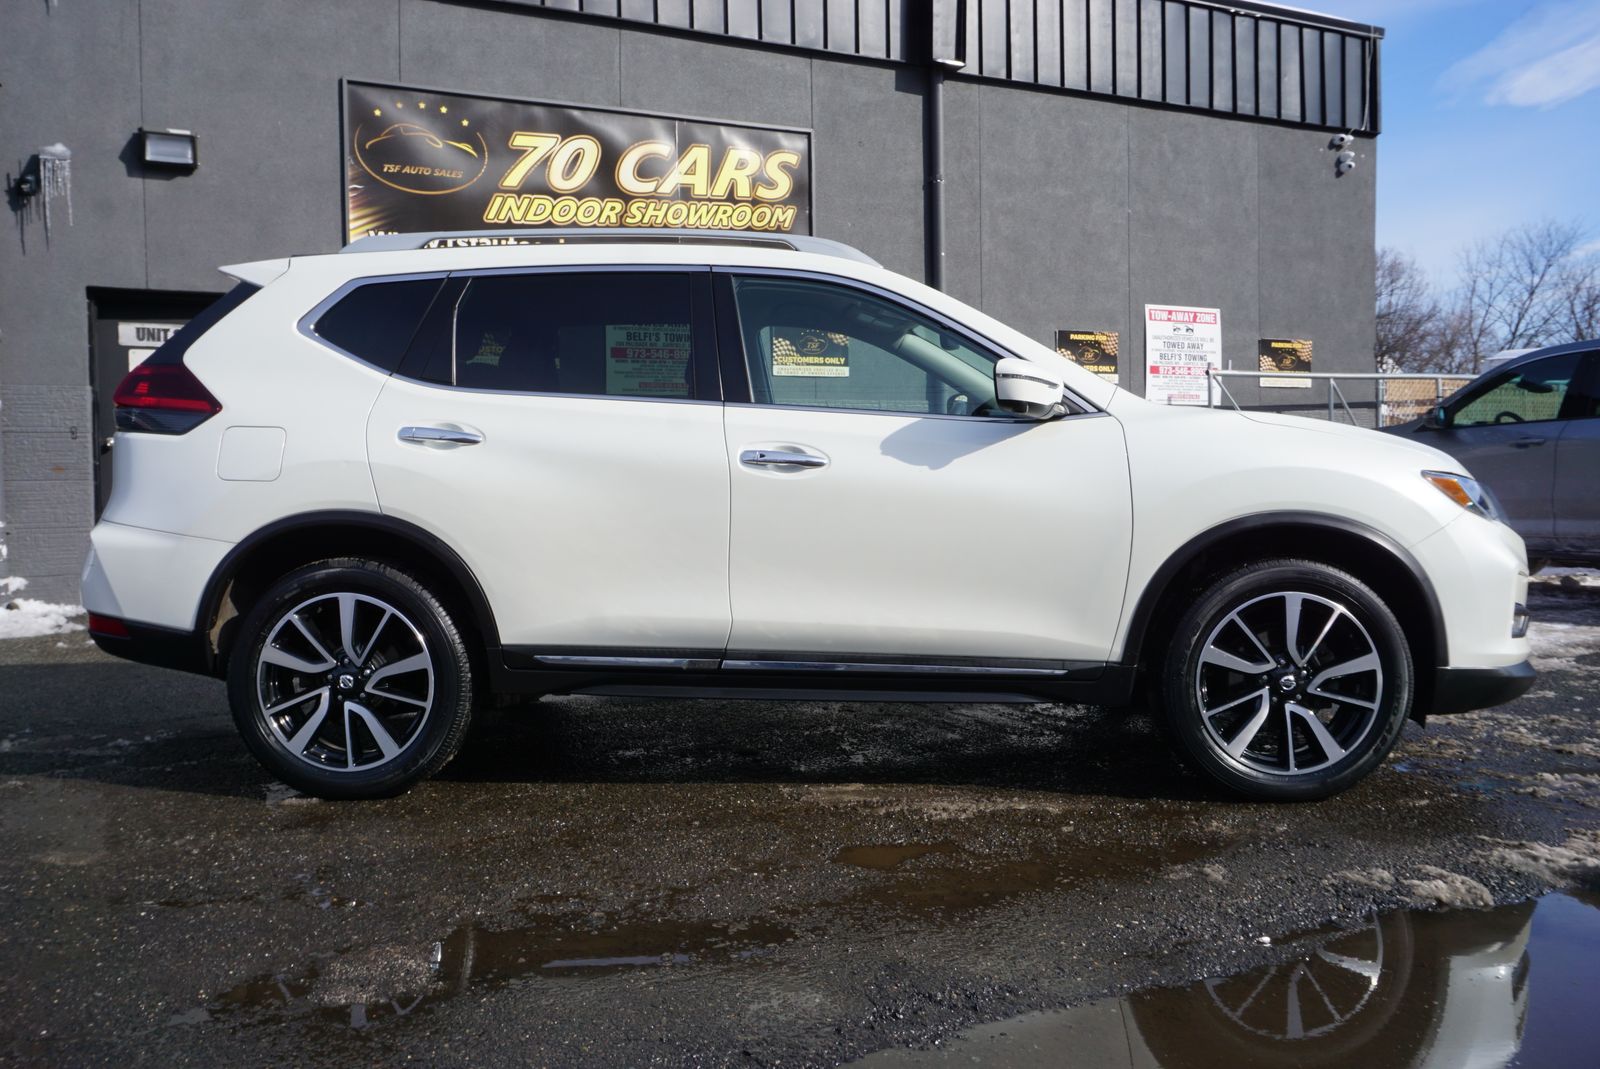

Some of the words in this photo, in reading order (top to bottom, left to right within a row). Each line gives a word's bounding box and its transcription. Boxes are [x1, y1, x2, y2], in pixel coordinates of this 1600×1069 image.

[383, 164, 401, 173] TSF
[402, 165, 432, 175] AUTO
[433, 168, 464, 178] SALES
[499, 131, 601, 193] 70
[616, 140, 800, 201] CARS
[483, 193, 625, 226] INDOOR
[625, 199, 797, 231] SHOWROOM
[1150, 309, 1195, 322] TOW-AWAY
[1196, 312, 1216, 323] ZONE
[135, 327, 170, 342] UNIT
[626, 331, 660, 341] BELFI'S
[1162, 341, 1185, 349] TOWED
[1187, 342, 1204, 350] AWAY
[824, 357, 846, 365] ONLY
[1159, 353, 1182, 361] BELFI'S
[1184, 354, 1207, 362] TOWING
